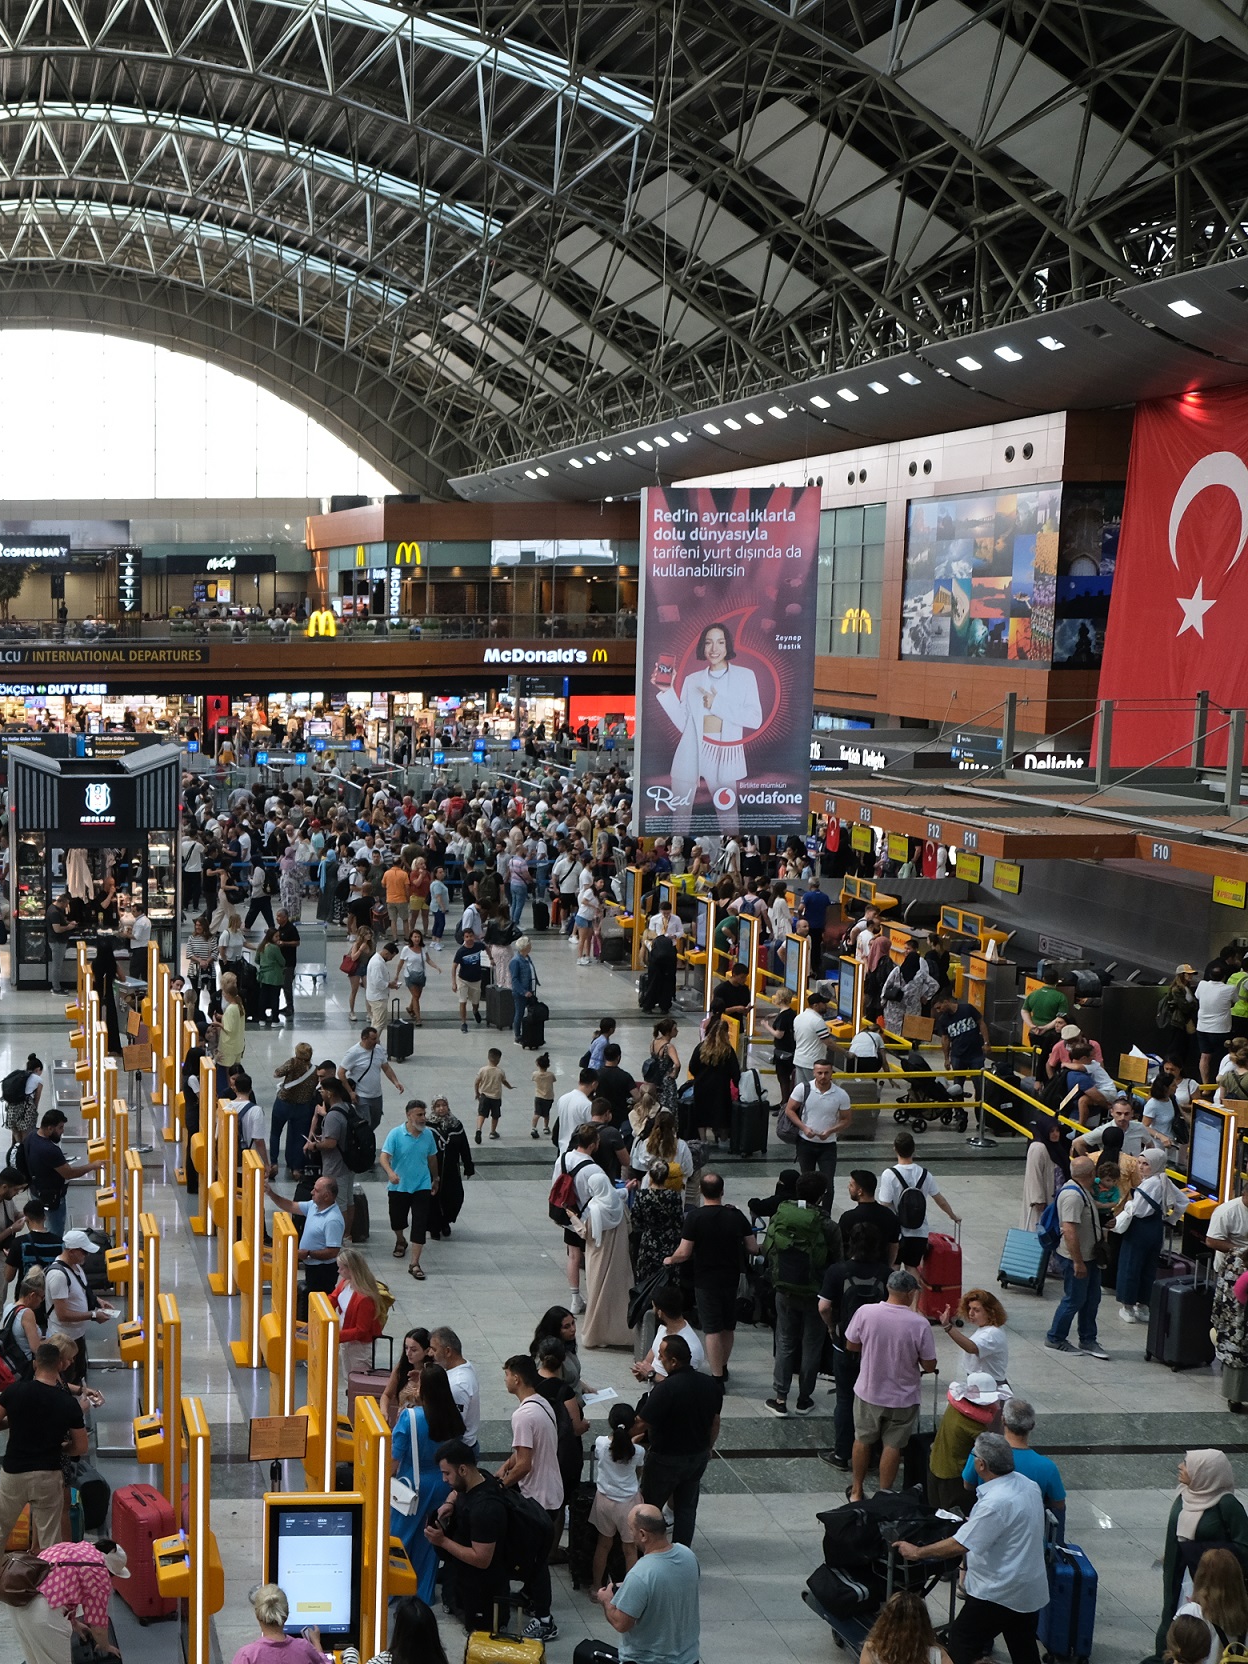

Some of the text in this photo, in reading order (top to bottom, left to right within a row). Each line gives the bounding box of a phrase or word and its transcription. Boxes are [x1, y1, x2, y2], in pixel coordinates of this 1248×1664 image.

[653, 509, 796, 525] Red’in ayrıcalıklarla
[653, 527, 769, 543] dolu dünyasıyla
[653, 545, 802, 562] tarifeni yurt dışında da
[653, 564, 745, 577] kullanabilirsin
[776, 634, 802, 642] Zeynep
[32, 650, 125, 662] INTERNATIONAL
[129, 650, 202, 661] DEPARTURES
[47, 684, 78, 695] DUTY
[79, 684, 108, 694] FREE
[646, 786, 693, 811] Red
[740, 791, 802, 804] vodafone
[928, 822, 940, 838] F12
[964, 832, 977, 848] F11
[1153, 844, 1168, 860] F10
